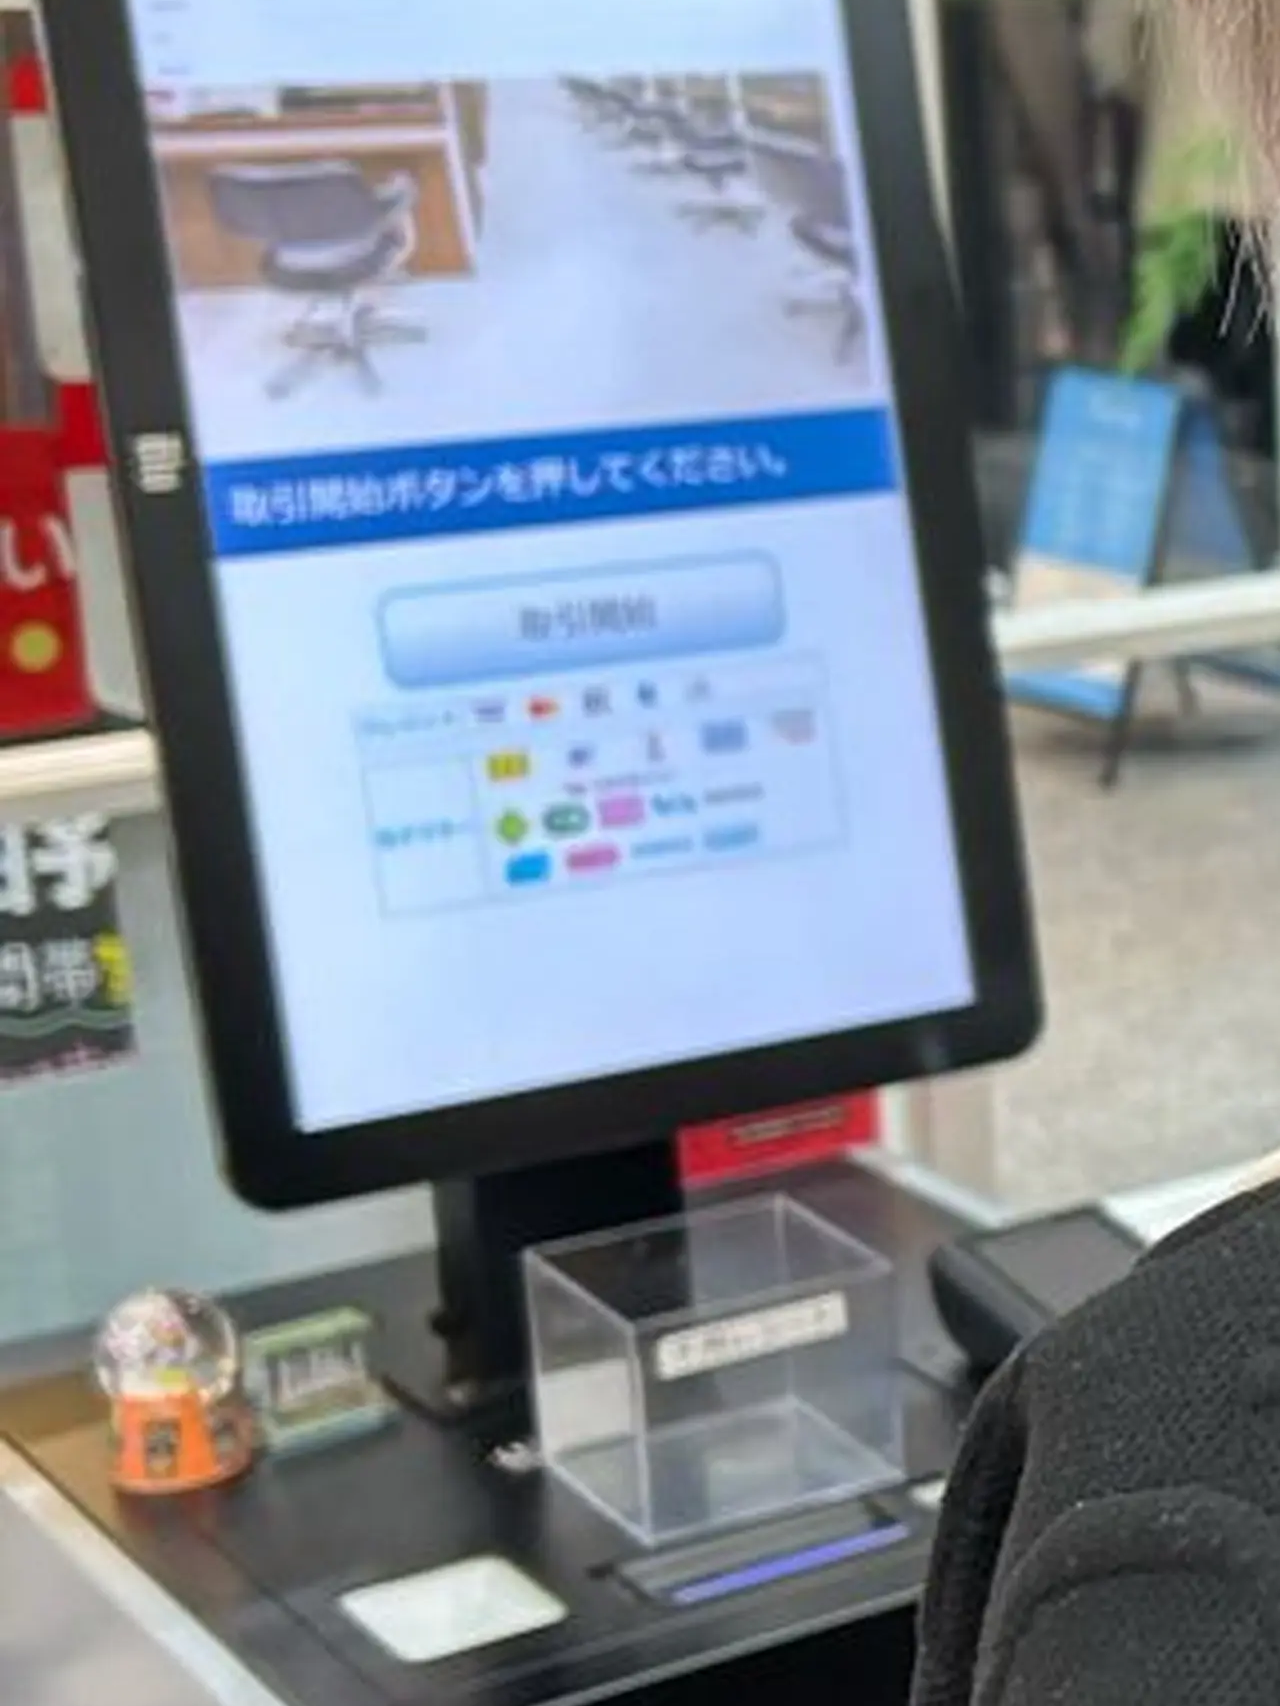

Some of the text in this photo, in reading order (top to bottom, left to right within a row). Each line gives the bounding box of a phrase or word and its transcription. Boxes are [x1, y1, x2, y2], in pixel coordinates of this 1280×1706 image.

[228, 441, 790, 527] 取引開始ボタンを押してください。
